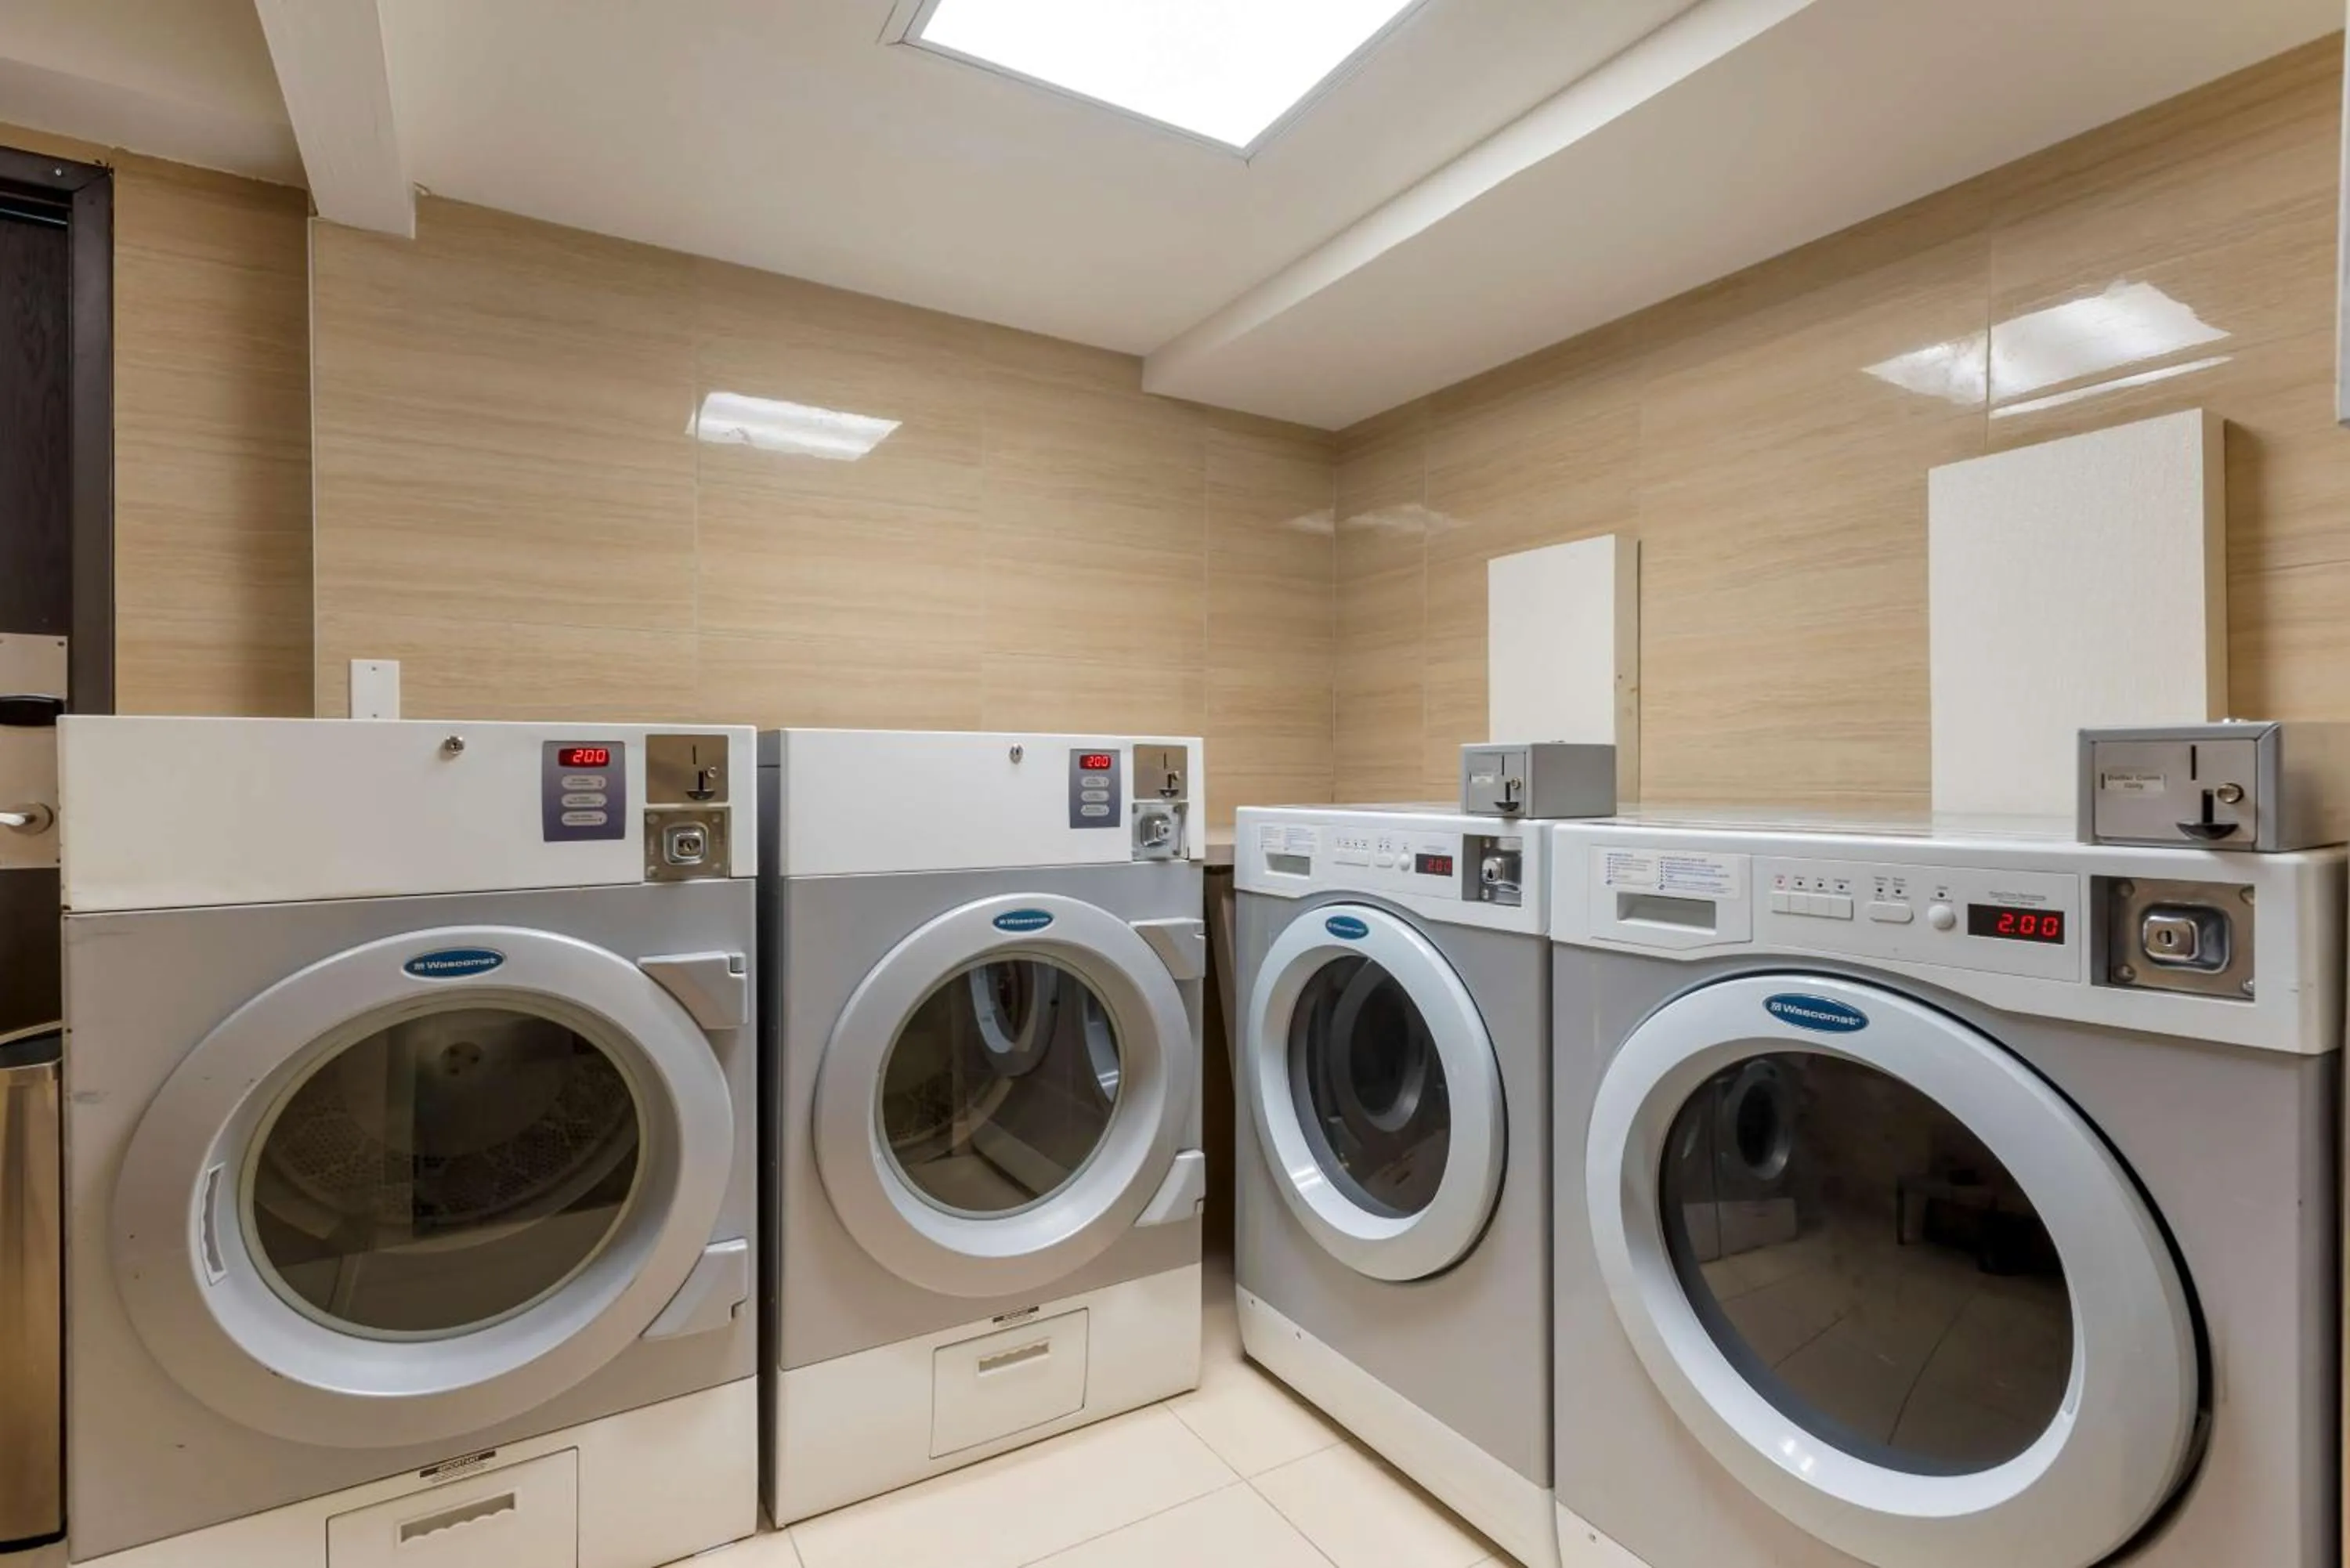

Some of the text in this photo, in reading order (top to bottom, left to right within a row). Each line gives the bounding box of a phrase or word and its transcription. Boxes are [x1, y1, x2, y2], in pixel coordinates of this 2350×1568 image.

[573, 750, 606, 763] 200
[1998, 912, 2058, 936] 2.00
[426, 957, 497, 969] Wascomat
[1783, 1003, 1856, 1025] Wascomat
